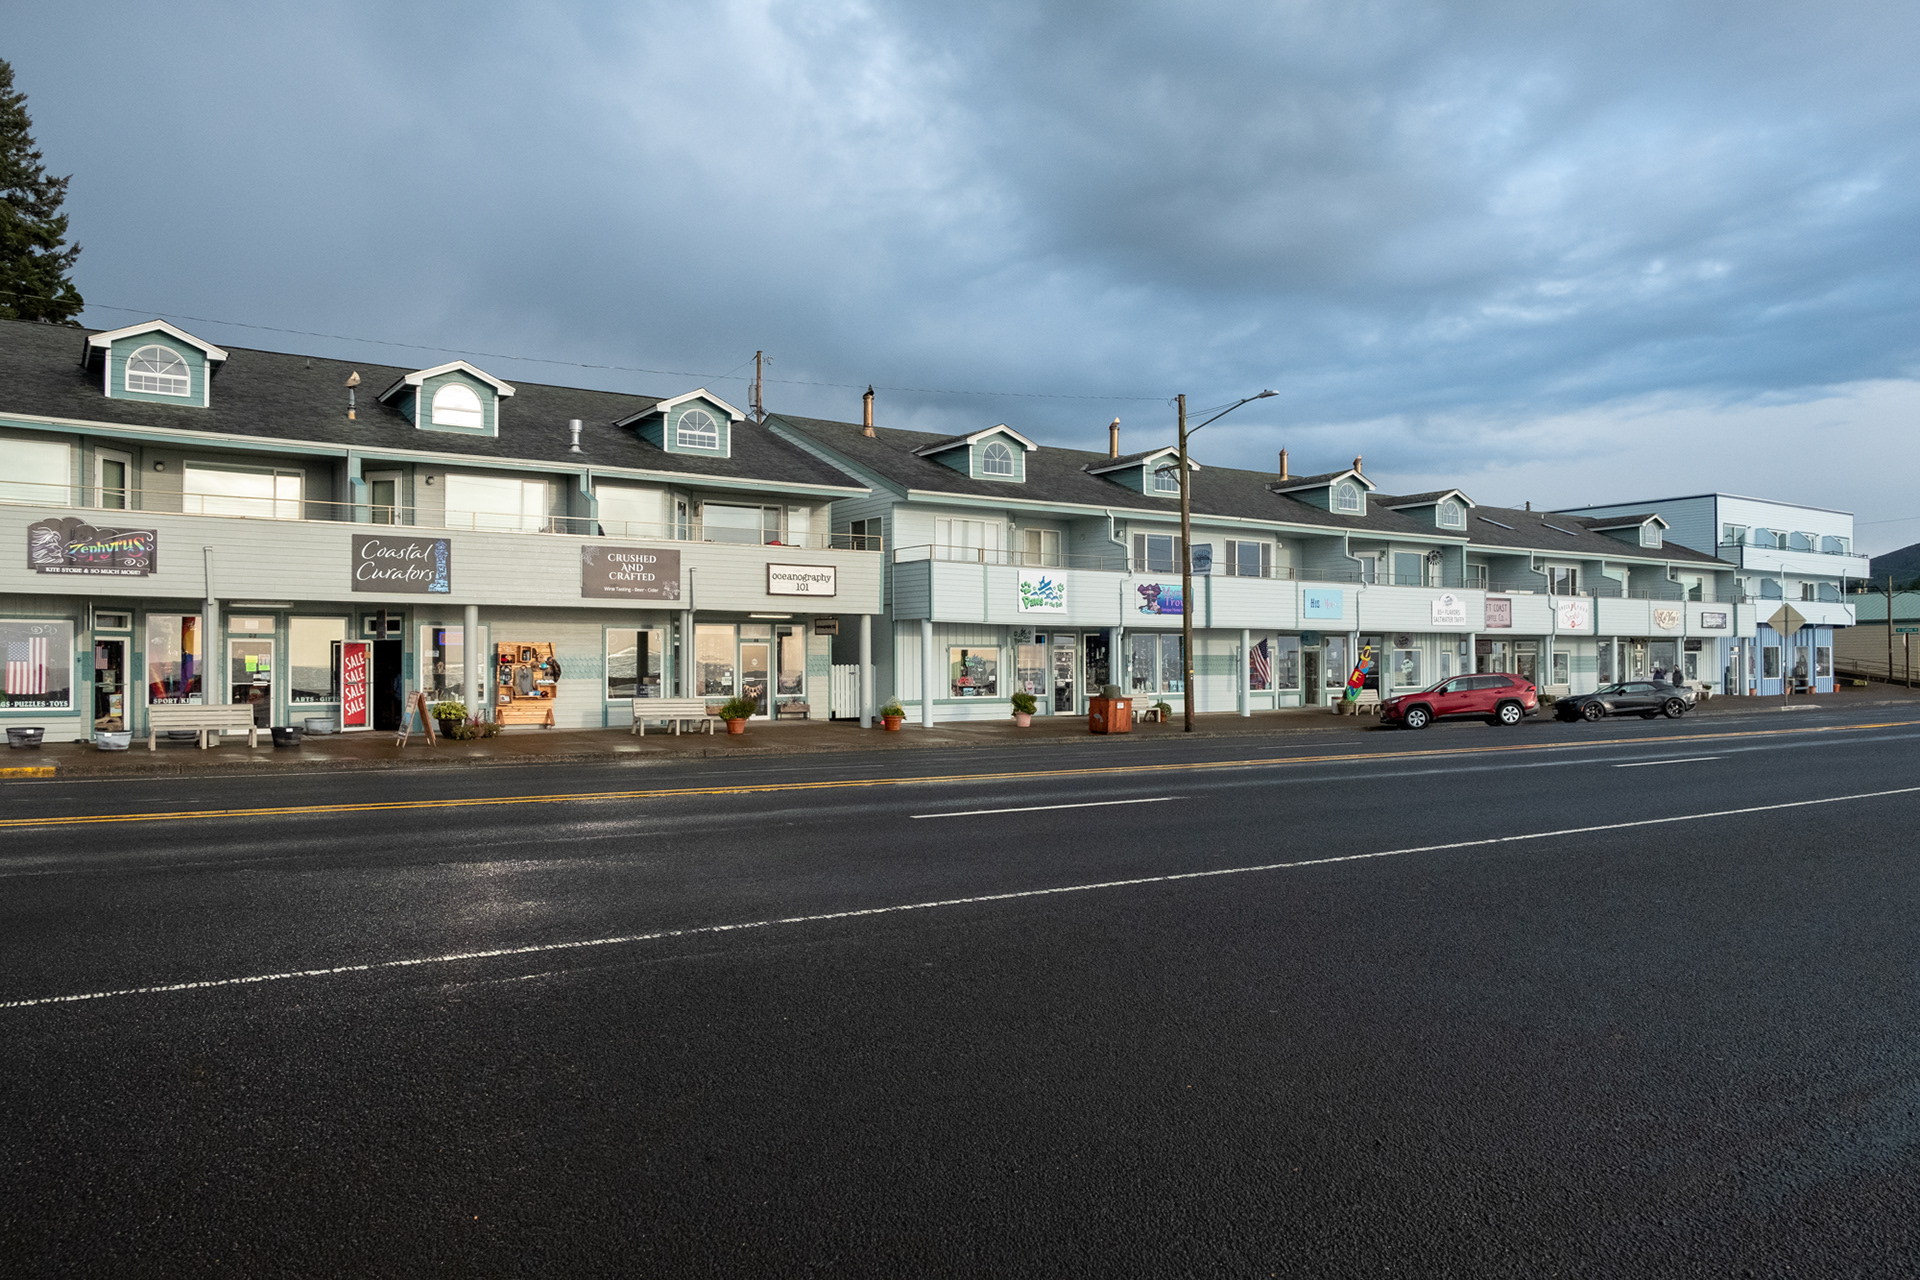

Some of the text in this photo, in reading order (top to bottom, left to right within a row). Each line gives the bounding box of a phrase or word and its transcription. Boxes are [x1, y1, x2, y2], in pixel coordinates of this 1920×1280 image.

[68, 536, 145, 561] Zephyrus
[361, 539, 434, 562] Coastal
[607, 553, 657, 563] CRUSHED
[356, 561, 434, 582] Curators
[621, 562, 644, 573] AND
[608, 572, 656, 581] CRAFTED
[772, 572, 832, 584] oceanography
[796, 582, 809, 592] 101
[1165, 597, 1183, 607] Tro
[1493, 603, 1507, 612] COAST
[345, 651, 365, 670] SALE
[345, 667, 365, 683] SALE
[345, 682, 365, 700] SALE
[345, 697, 365, 716] SALE
